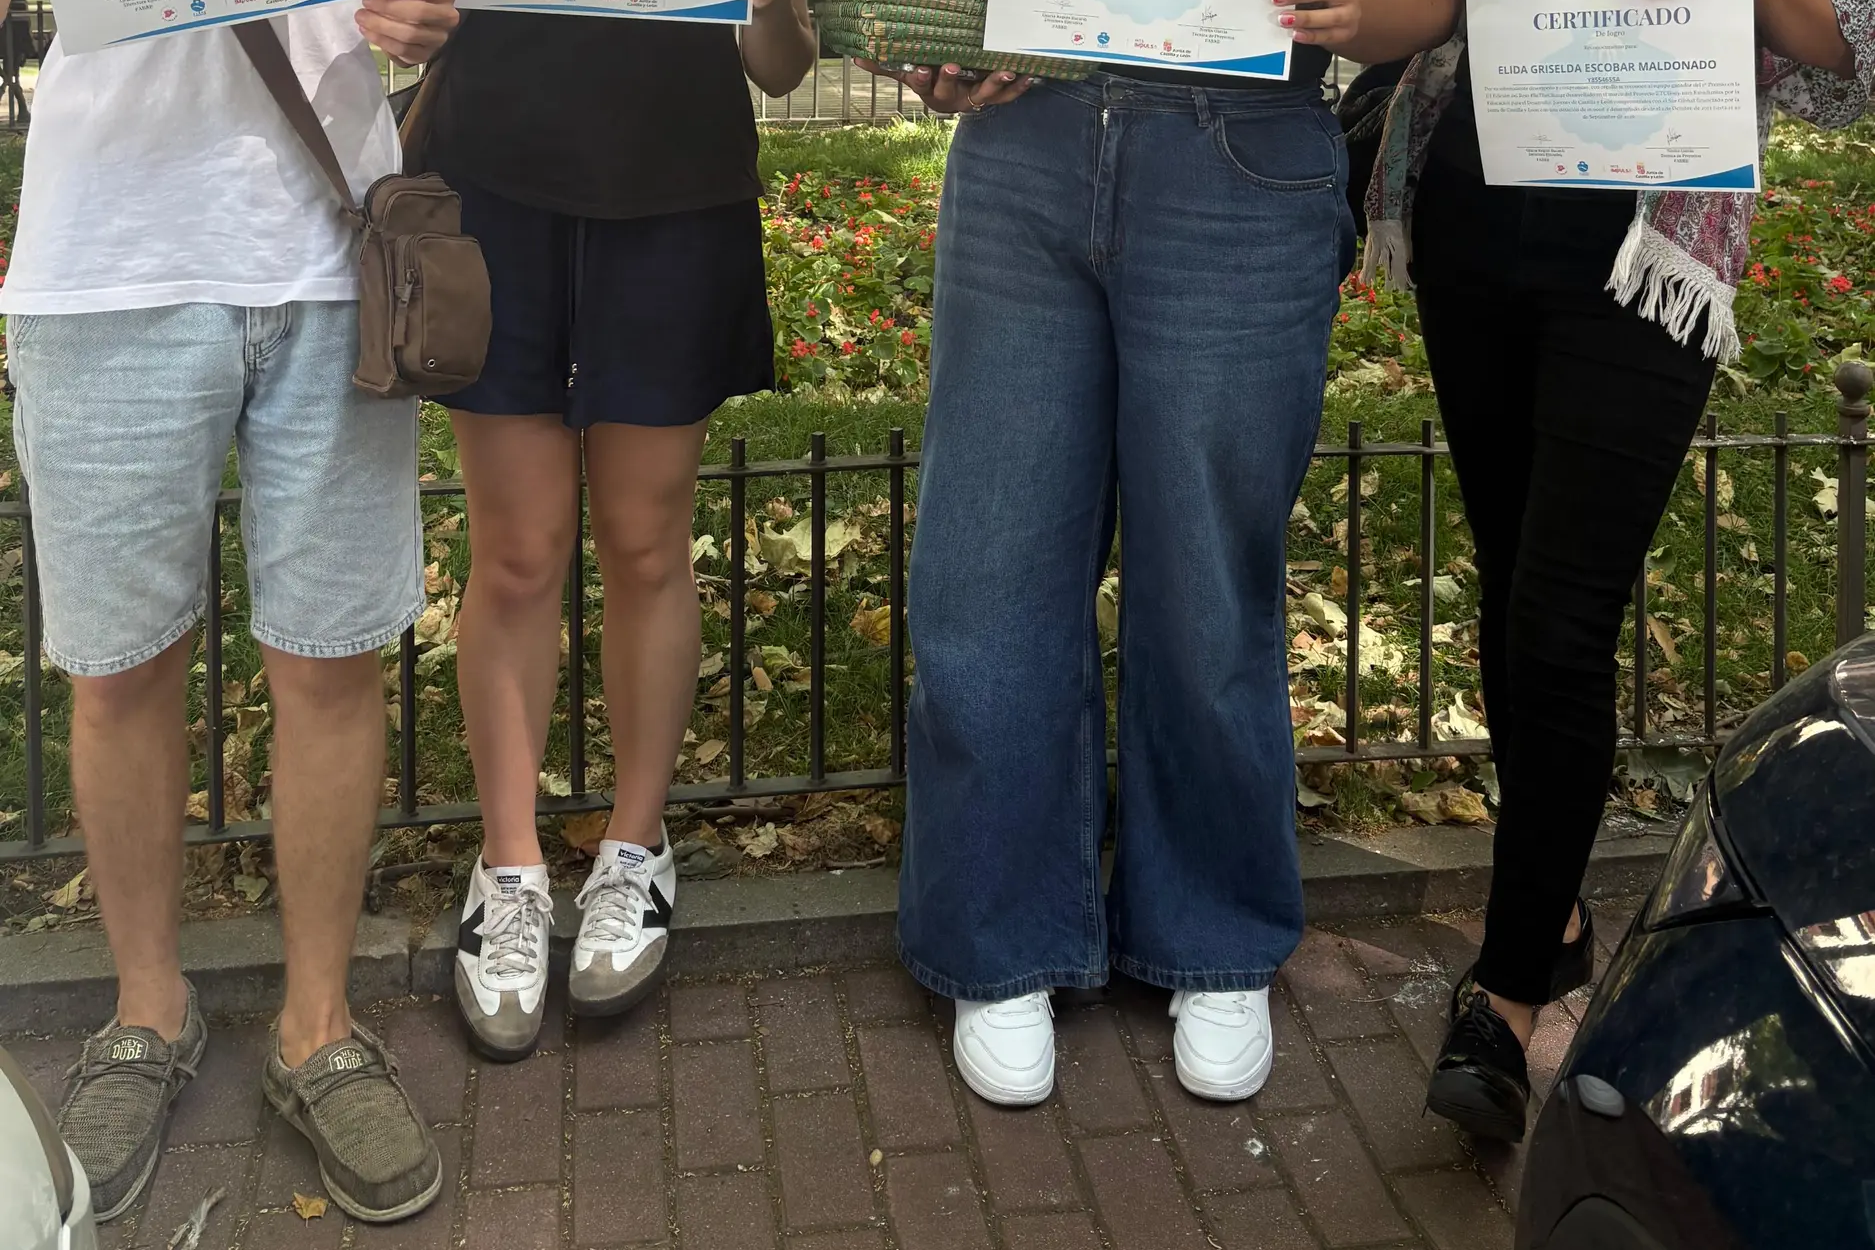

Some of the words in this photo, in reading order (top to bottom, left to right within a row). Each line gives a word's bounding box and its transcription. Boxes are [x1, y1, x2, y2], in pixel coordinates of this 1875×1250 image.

[1532, 5, 1691, 30] CERTIFICADO
[1606, 29, 1625, 37] logro
[1497, 65, 1528, 74] ELIDA
[1529, 63, 1582, 74] GRISELDA
[1584, 62, 1635, 72] ESCOBAR
[1638, 59, 1717, 71] MALDONADO
[121, 1039, 139, 1047] HEY
[112, 1044, 143, 1061] DUDE
[340, 1049, 356, 1058] HEY
[333, 1053, 364, 1070] DUDE
